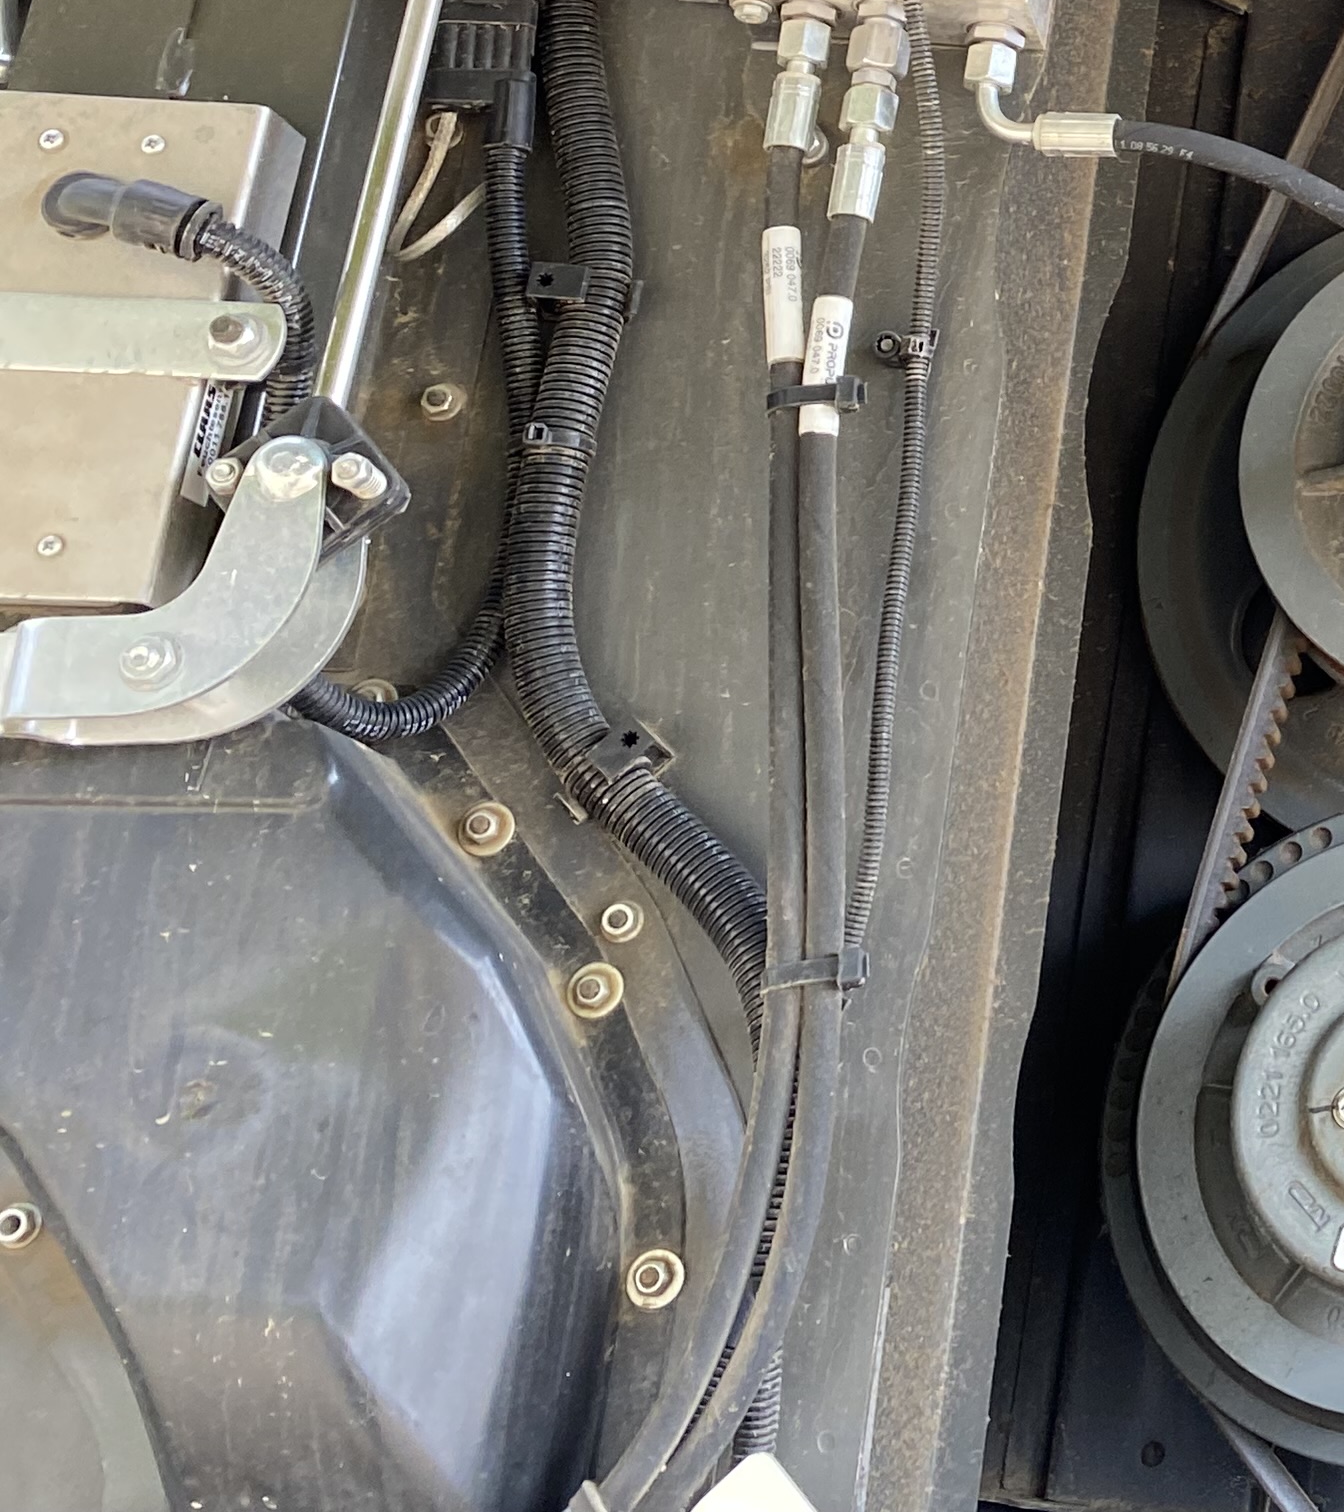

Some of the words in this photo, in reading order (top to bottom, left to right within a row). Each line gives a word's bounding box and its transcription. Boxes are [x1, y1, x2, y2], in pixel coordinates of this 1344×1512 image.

[772, 247, 783, 278] 22222
[785, 246, 796, 273] 0069
[194, 384, 216, 458] CLAAS
